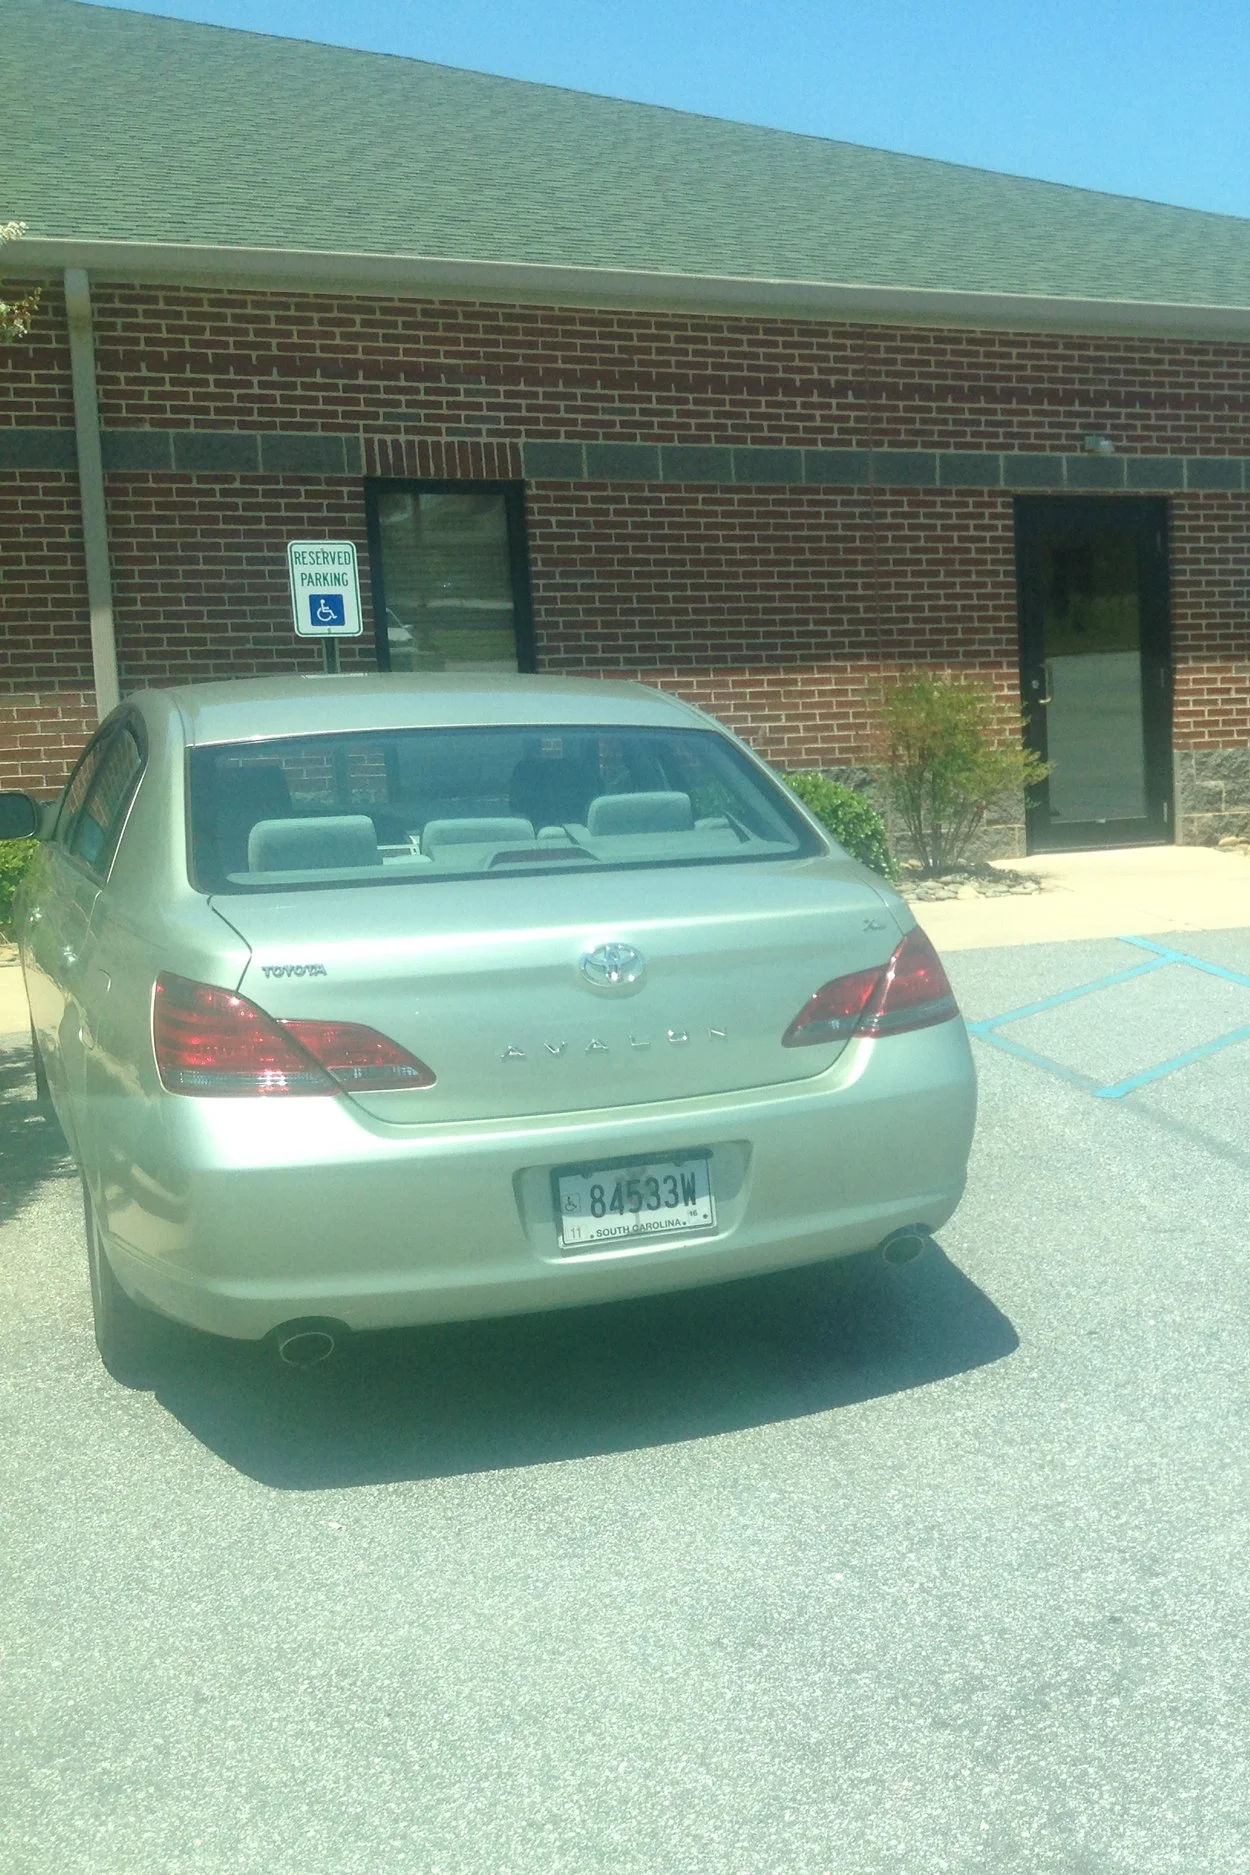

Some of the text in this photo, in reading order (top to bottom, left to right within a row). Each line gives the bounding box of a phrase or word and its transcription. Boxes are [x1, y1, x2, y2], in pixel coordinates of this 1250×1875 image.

[293, 551, 351, 566] RESERVED
[300, 572, 349, 587] PARKING
[261, 963, 328, 979] TOYOTA
[500, 1027, 728, 1062] AVALON
[589, 1171, 697, 1219] 84533W
[570, 1227, 582, 1239] 11
[596, 1218, 681, 1238] SOUTH CAROLINA
